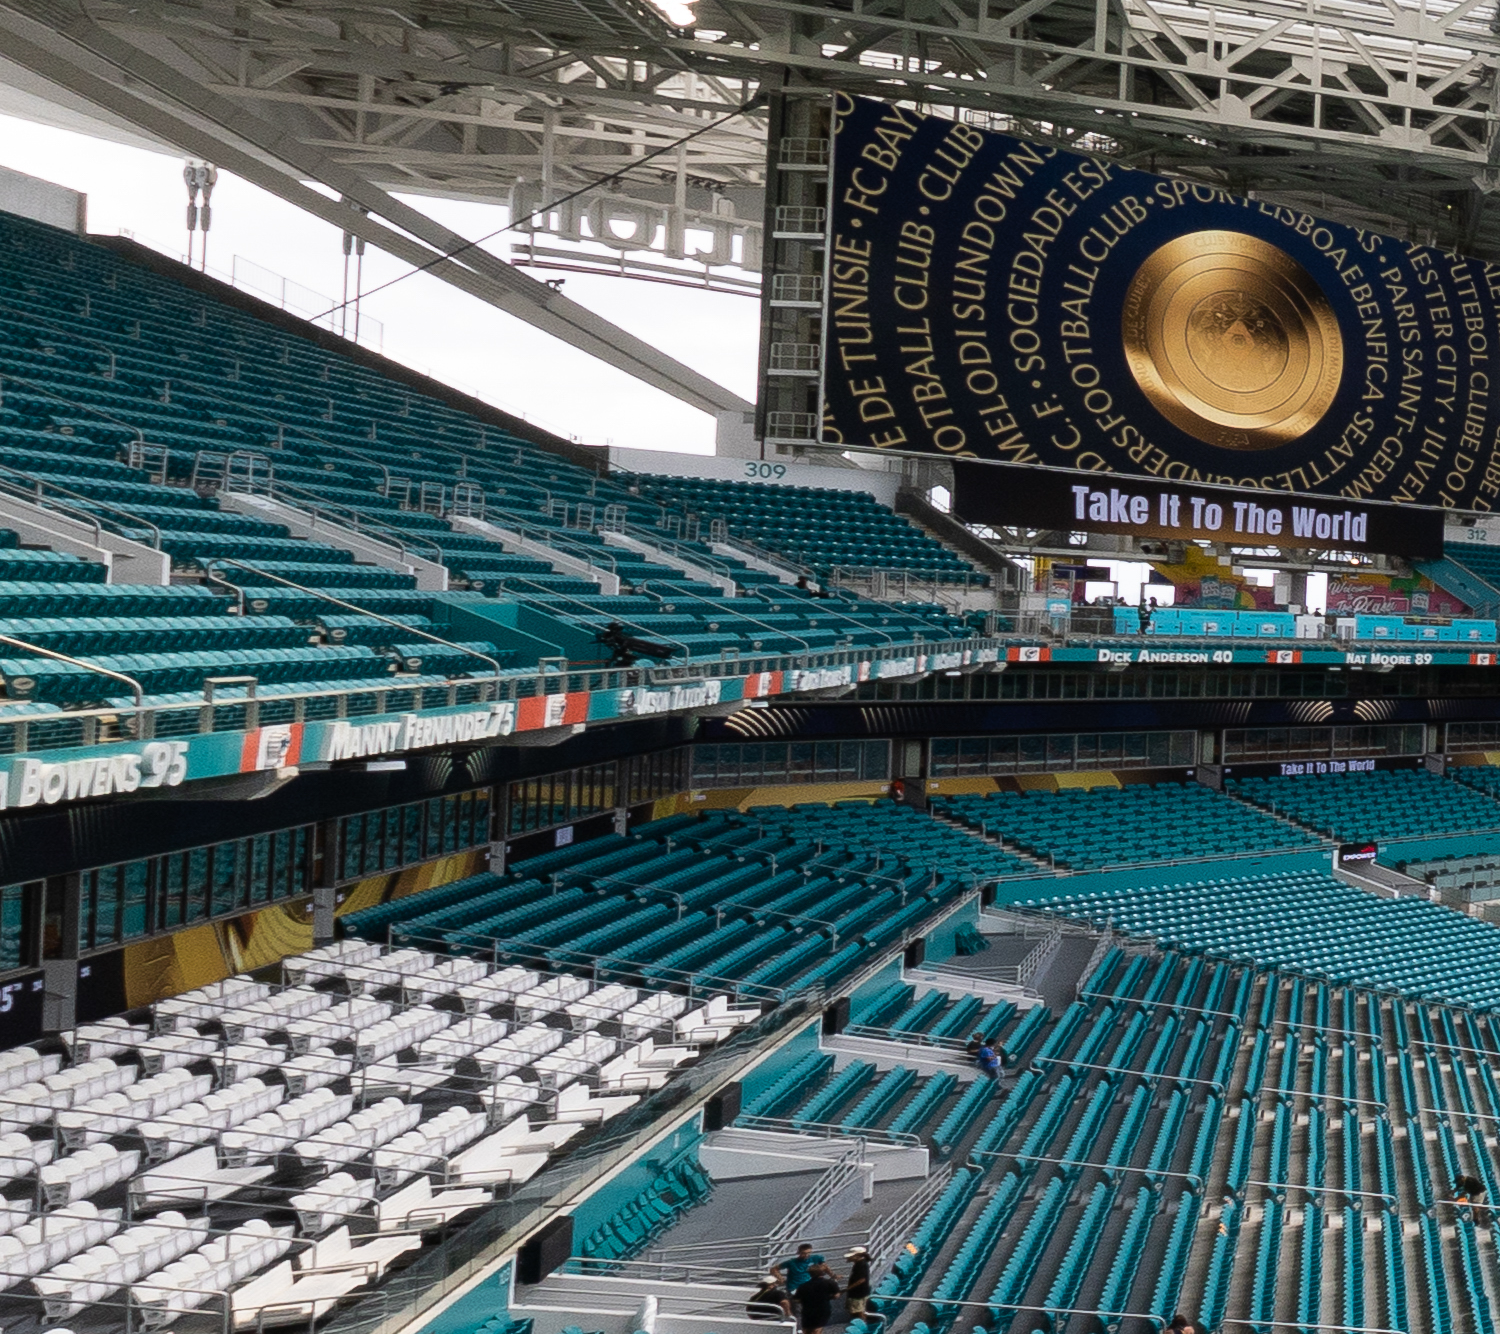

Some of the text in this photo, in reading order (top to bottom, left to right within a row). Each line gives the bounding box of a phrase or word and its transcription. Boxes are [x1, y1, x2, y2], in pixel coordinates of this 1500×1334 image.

[844, 167, 888, 214] FC
[918, 123, 985, 201] CLUB
[1007, 187, 1077, 372] SOCIEDADE
[1060, 194, 1148, 432] FOOTBALL CLUB
[1380, 265, 1420, 343] PARIS
[833, 234, 896, 423] DE TUNISIE
[894, 220, 978, 458] OTBALL CLUB
[1350, 282, 1389, 401] BENFICA
[1436, 343, 1457, 412] CITY
[1463, 369, 1489, 452] CLUBE
[744, 461, 787, 479] 309
[1276, 411, 1375, 492] SEATTLE
[1446, 455, 1475, 495] DO
[1071, 484, 1368, 543] Take It To The World
[1466, 529, 1488, 541] 312
